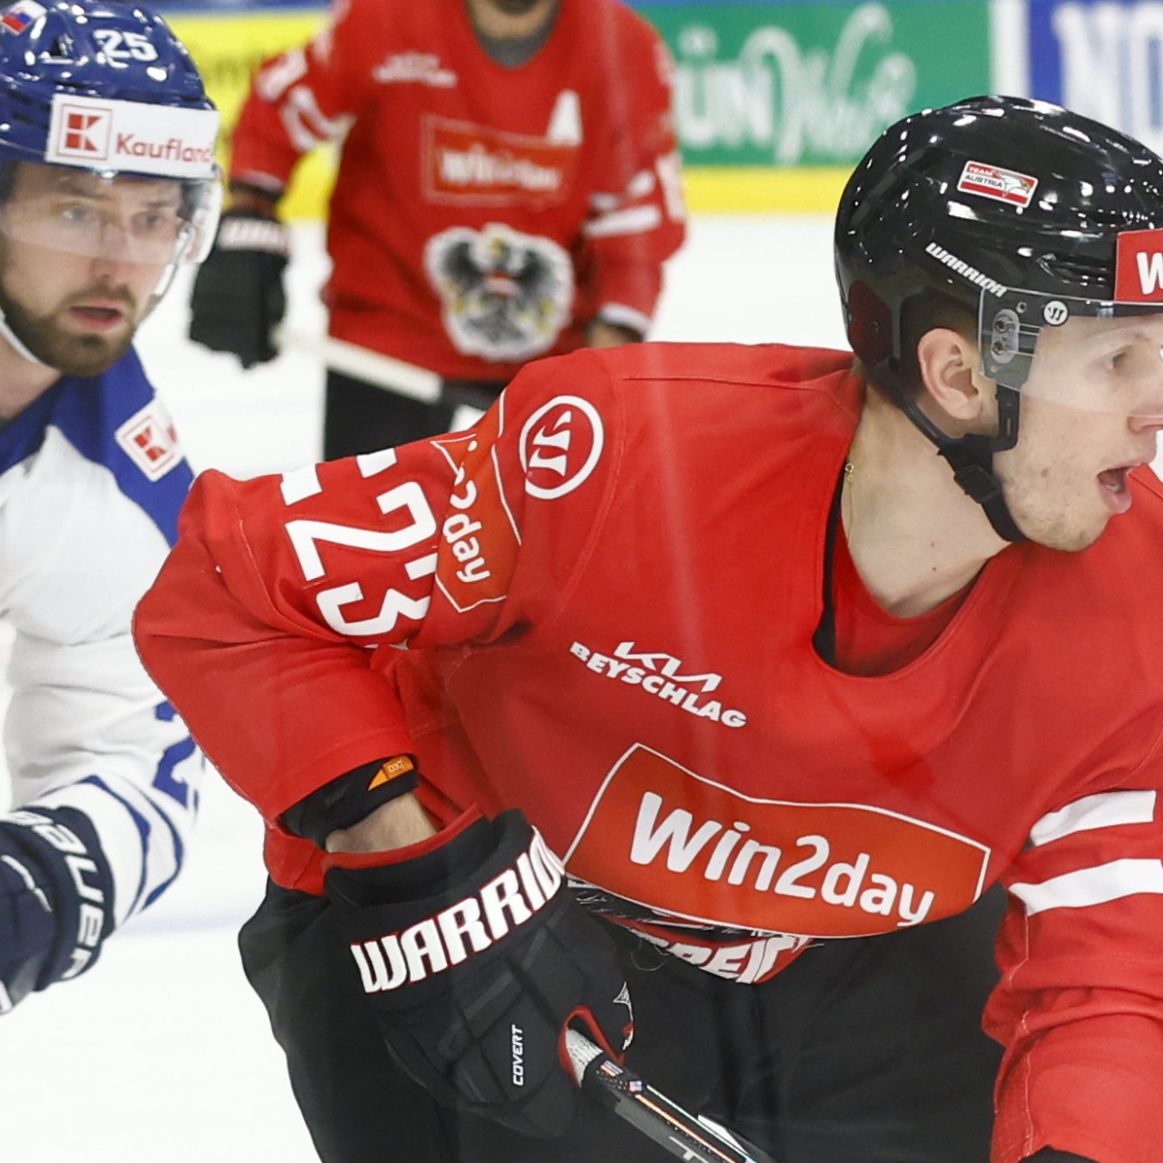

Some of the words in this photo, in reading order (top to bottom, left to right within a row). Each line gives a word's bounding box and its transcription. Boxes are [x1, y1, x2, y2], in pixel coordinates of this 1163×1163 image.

[93, 29, 159, 63] 25
[924, 242, 1008, 298] WARRIOR
[285, 480, 440, 638] 23
[569, 641, 747, 729] BEYSCHLAG
[349, 824, 566, 994] WARRIO
[511, 1023, 524, 1087] COVERT
